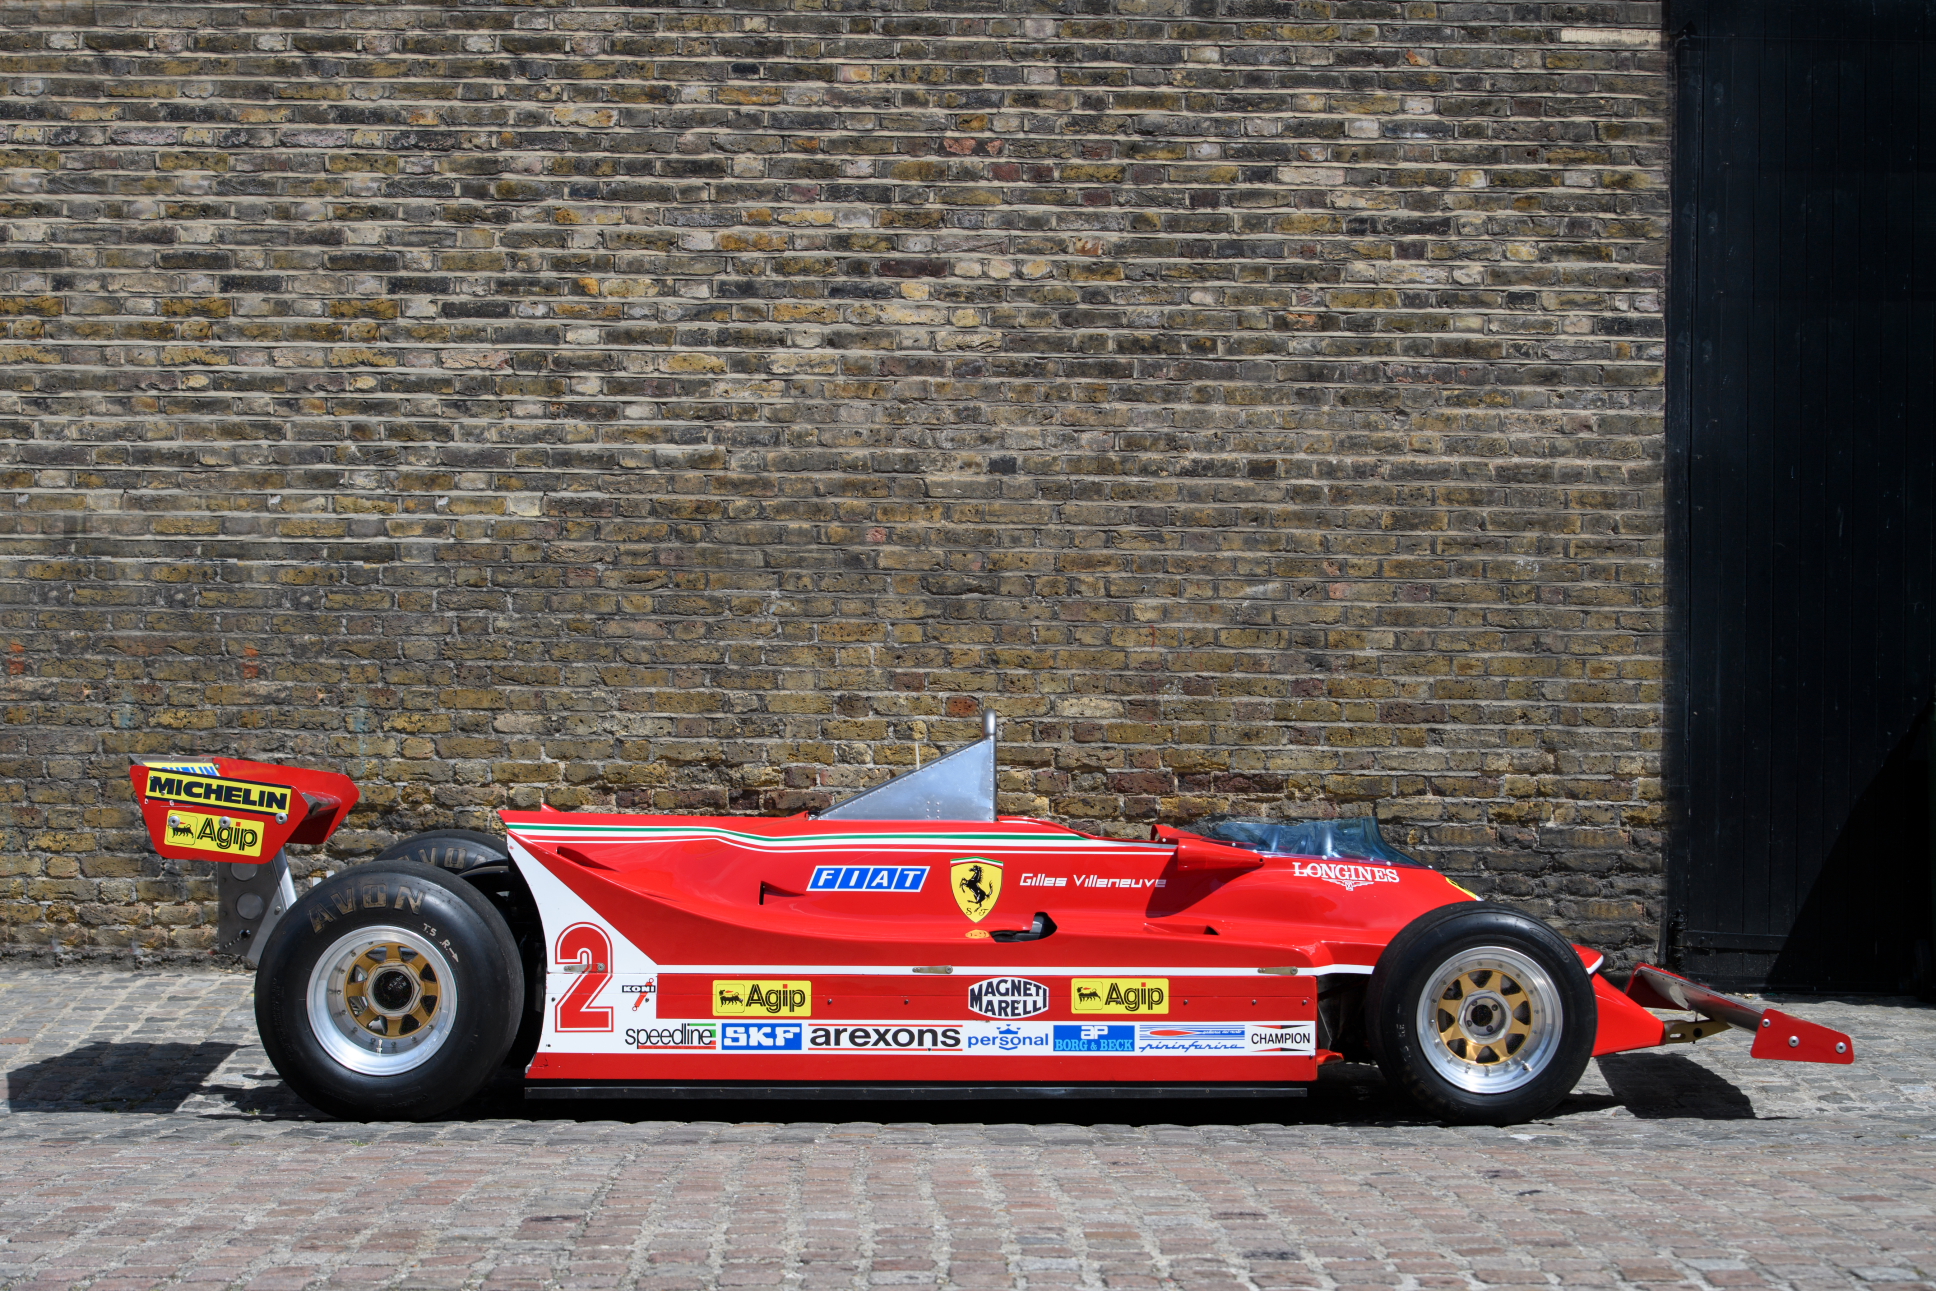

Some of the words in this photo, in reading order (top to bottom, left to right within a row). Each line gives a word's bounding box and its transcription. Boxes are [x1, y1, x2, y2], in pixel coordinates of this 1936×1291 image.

[149, 775, 288, 811] MICHELIN
[197, 817, 258, 851] Agip
[816, 869, 923, 888] FIAT
[1019, 873, 1068, 887] Gilles
[1073, 874, 1167, 888] Villeneuve
[1293, 862, 1400, 883] LONGINES
[307, 883, 428, 935] AVON
[555, 921, 614, 1033] 2
[623, 985, 655, 993] KONI
[745, 983, 806, 1014] Agip
[969, 979, 1047, 1000] MAGNETI
[1104, 982, 1164, 1012] Agip
[969, 999, 1047, 1017] MARELLI
[625, 1023, 713, 1050] speedline
[723, 1026, 801, 1047] SKF
[810, 1027, 961, 1048] arexons
[968, 1033, 1049, 1048] personal
[1055, 1039, 1088, 1051] BORG
[1090, 1041, 1098, 1050] &
[1100, 1039, 1133, 1051] BECK
[1138, 1040, 1245, 1052] pininfarina
[1251, 1033, 1311, 1045] CHAMPION
